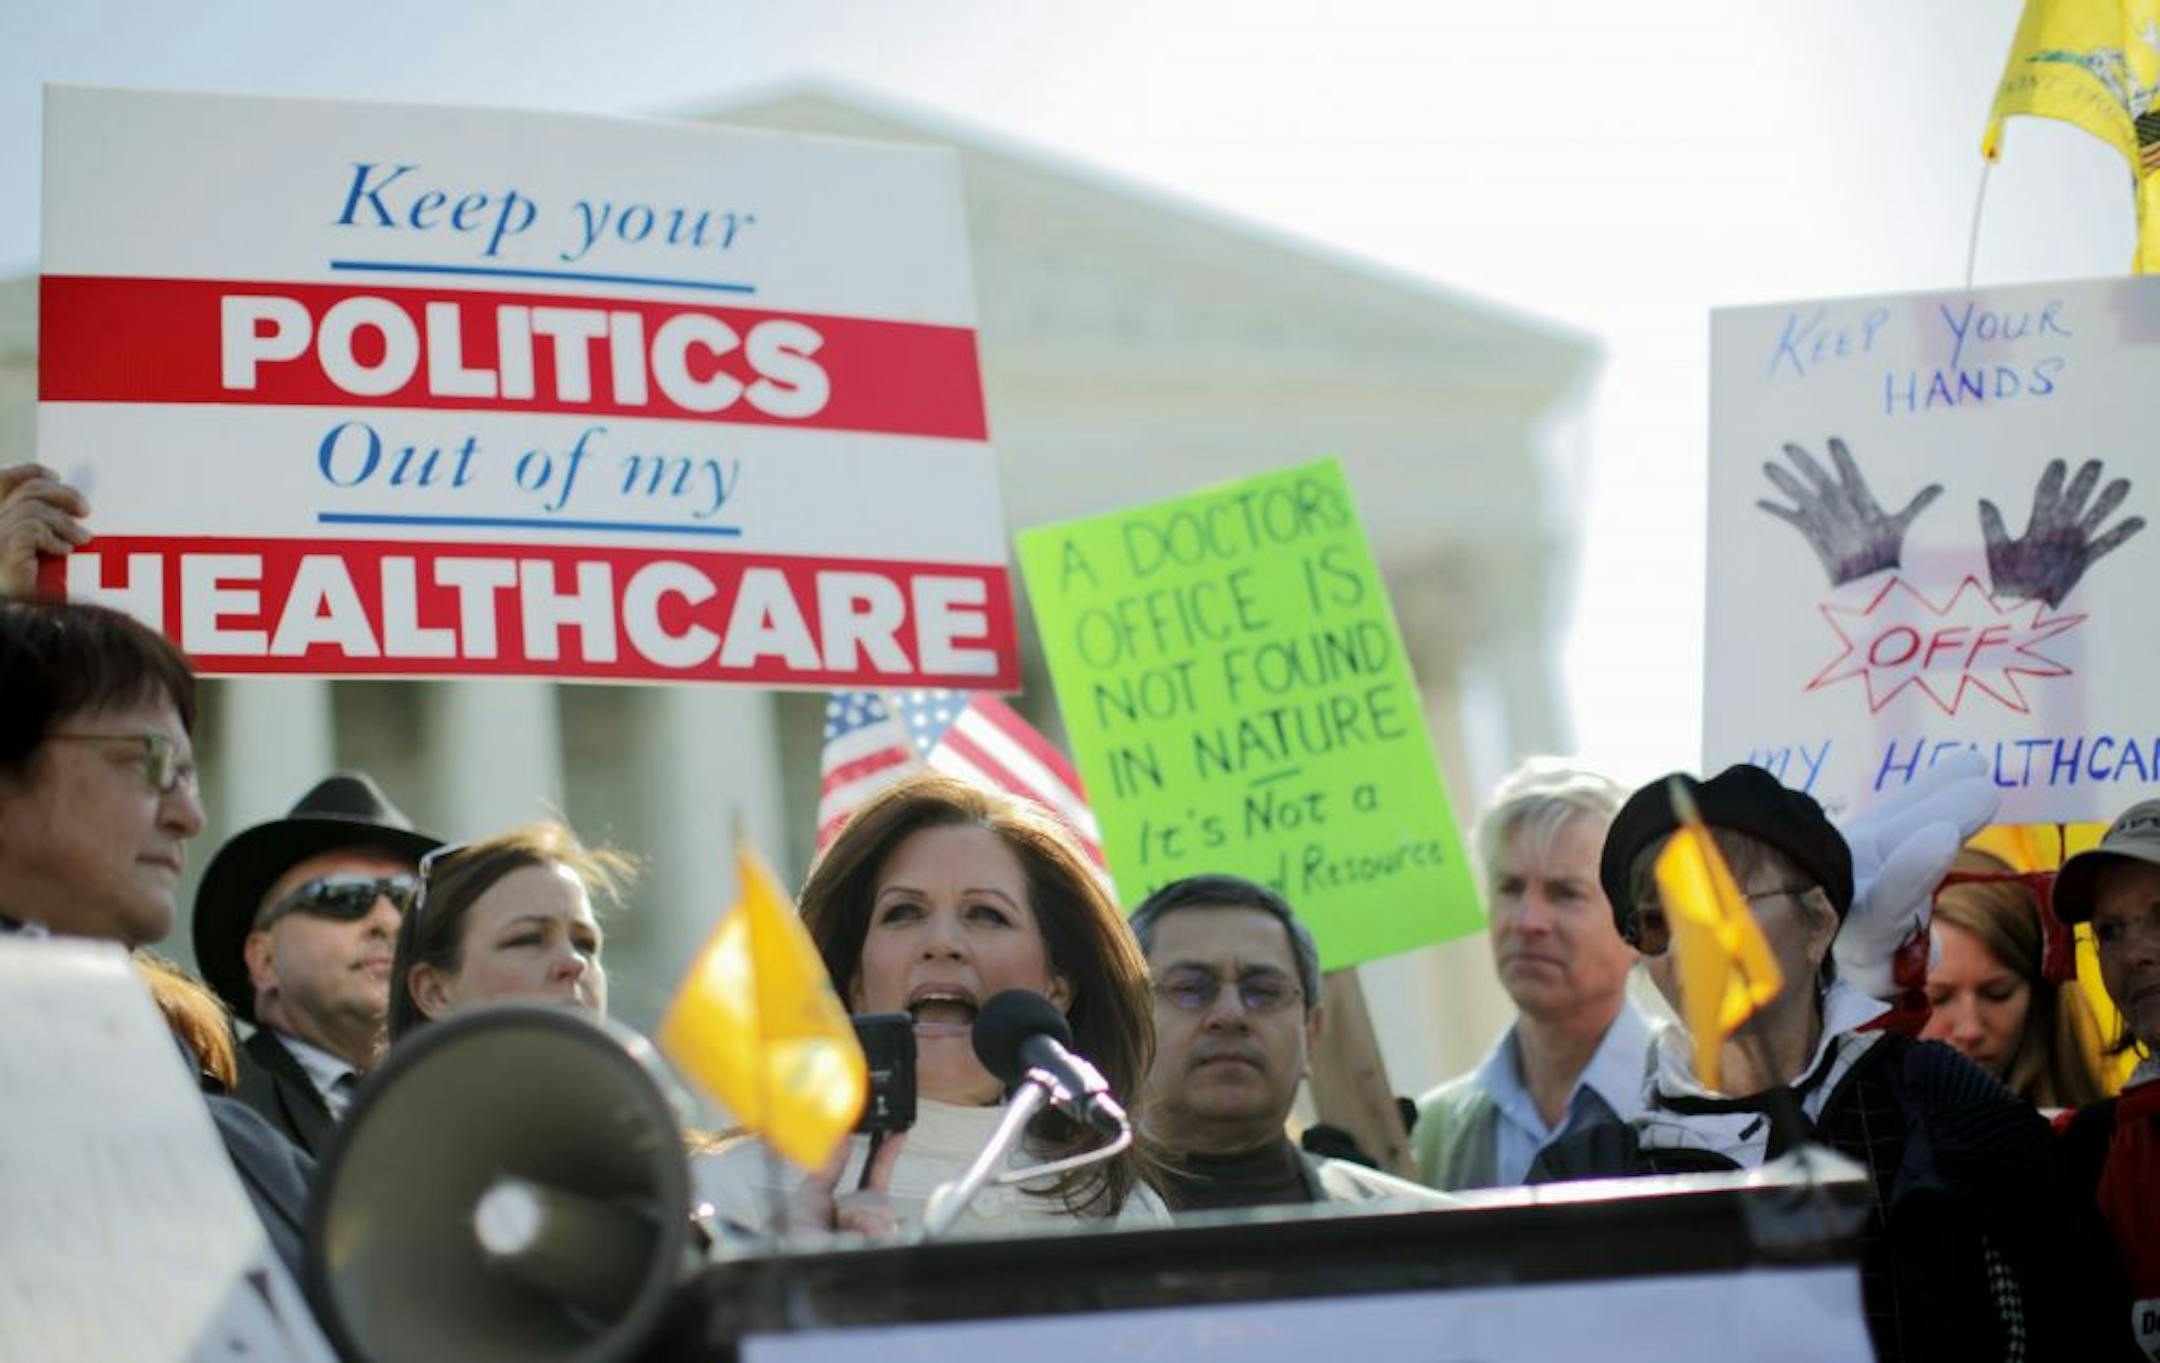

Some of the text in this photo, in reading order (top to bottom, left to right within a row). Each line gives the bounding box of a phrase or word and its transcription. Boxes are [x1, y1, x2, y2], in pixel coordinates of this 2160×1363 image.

[335, 163, 757, 262] Keep your
[220, 294, 829, 418] POLITICS
[1940, 303, 2073, 369] YOUR
[1886, 357, 2064, 415] HANDS
[317, 421, 742, 518] Out of my
[66, 553, 998, 676] HEALTHCARE
[1061, 540, 1099, 593] A
[1076, 545, 1364, 670] OFFICE IS
[1095, 621, 1393, 730] NOT FOUND
[1869, 626, 2010, 669] OFF
[1107, 685, 1406, 799] IN NATURE
[1303, 840, 1444, 894] Resource
